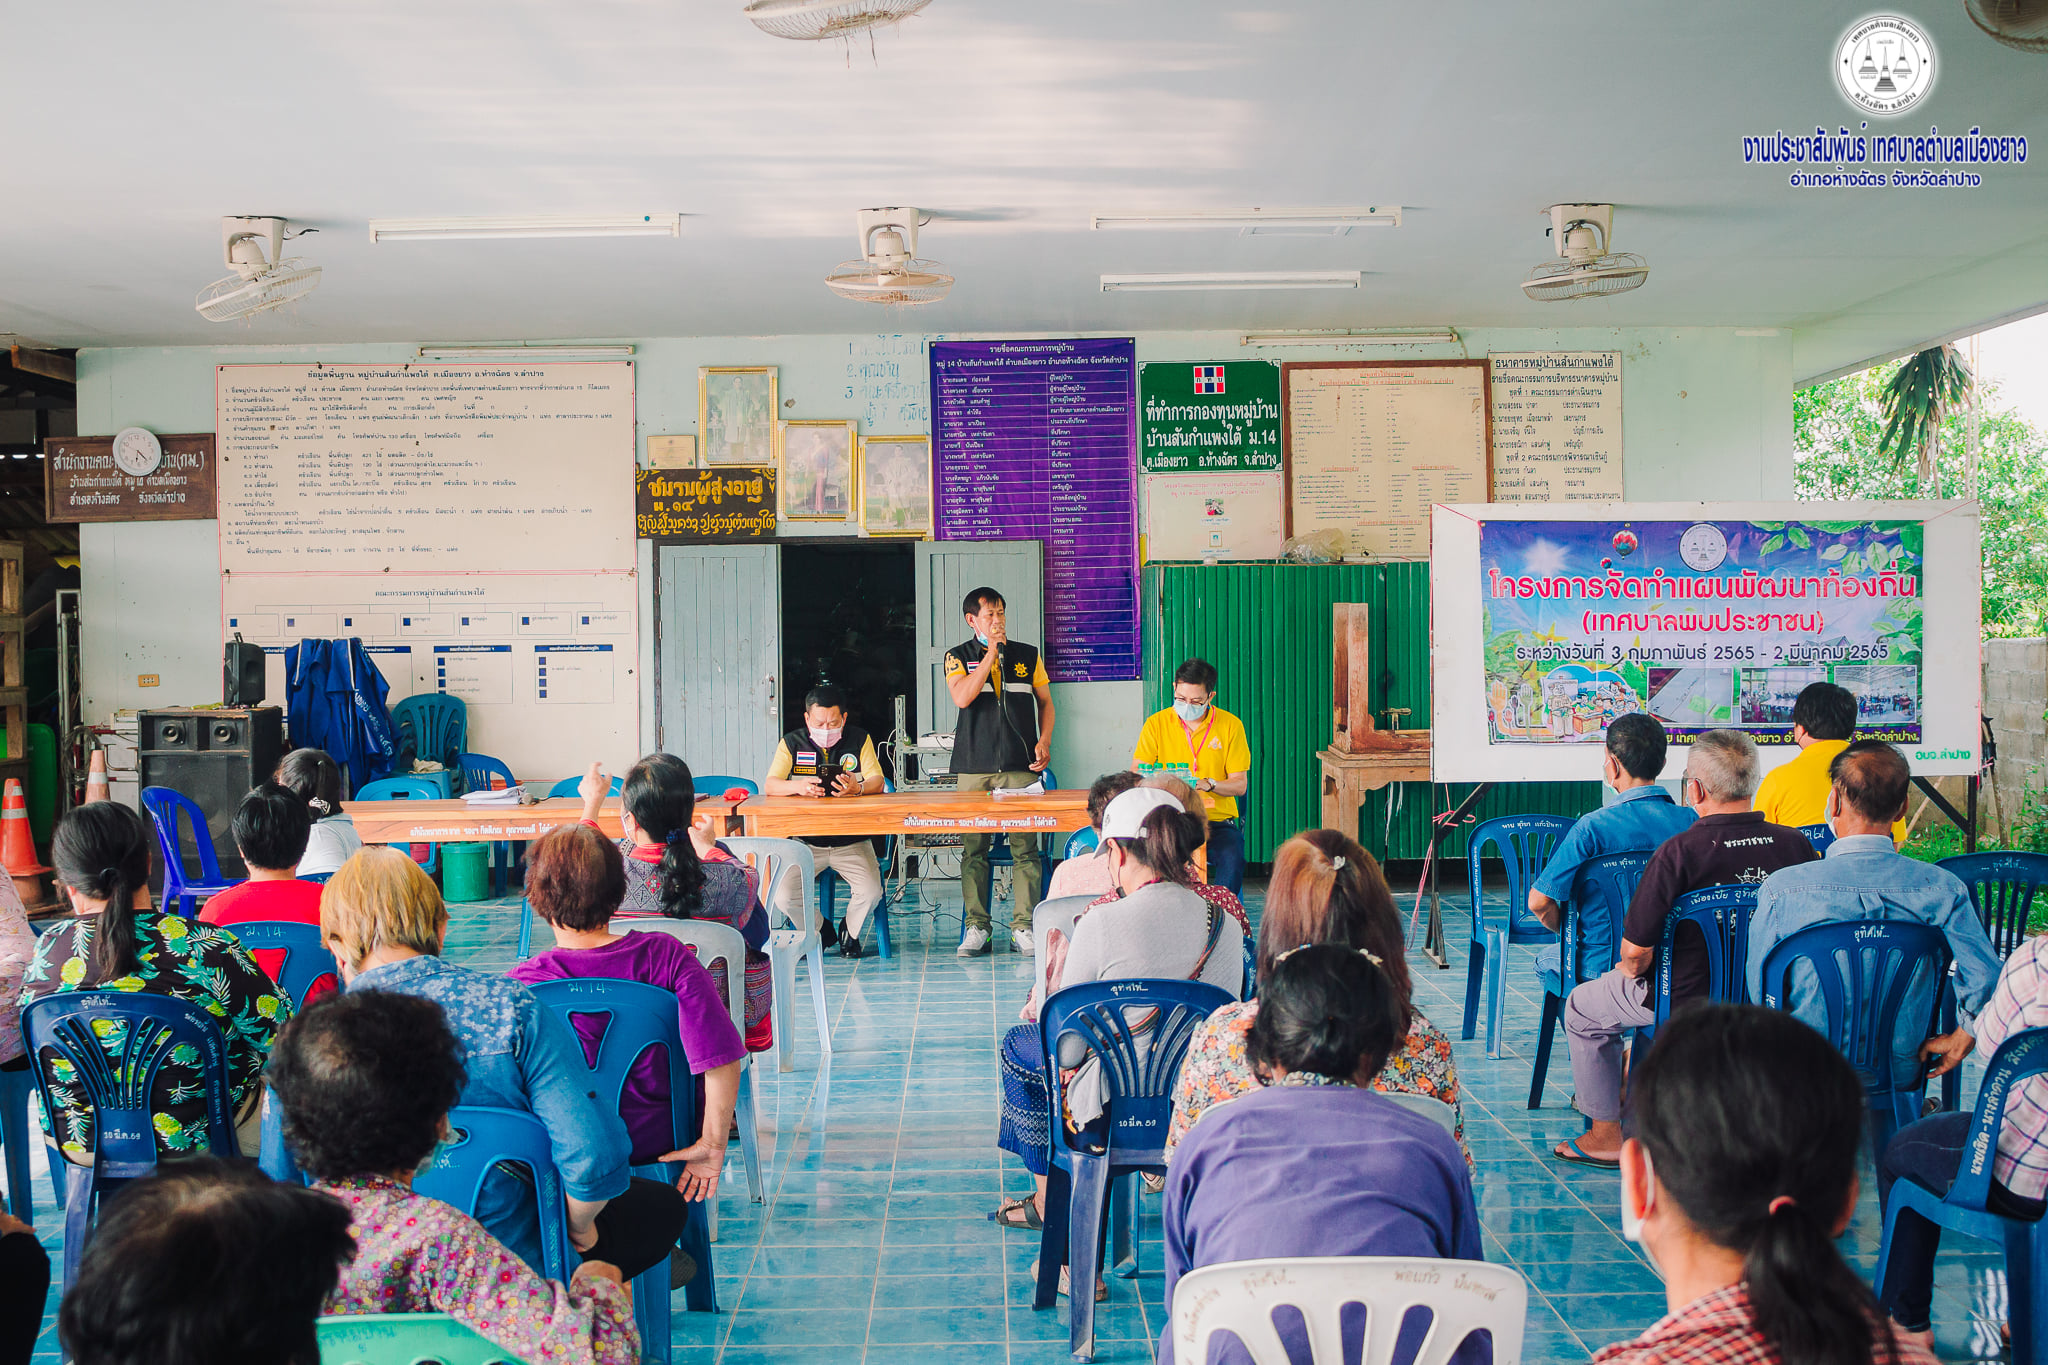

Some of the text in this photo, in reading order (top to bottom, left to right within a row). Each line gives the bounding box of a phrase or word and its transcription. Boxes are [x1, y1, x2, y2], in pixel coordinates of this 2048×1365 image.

[989, 343, 1074, 354] รายชื่อคณะกรรมการหมู่บ้าน
[1495, 354, 1613, 371] ธนาคารหมู่บ้านสันกำแพงใต้
[1146, 395, 1278, 427] ที่ทำการกองทุนหมู่บ้าน
[1147, 424, 1276, 447] บ้านสันกำแพงใต้ ม.14
[1147, 451, 1276, 468] ต.เมืองยาว อ.ห้างฉัตร จ.ลำปาง
[1489, 559, 1916, 601] โครงการจัดทำแผนพัฒนาท้องถิ่น
[1581, 607, 1825, 636] (เทศบาลพบประชาชน)
[1516, 637, 1605, 662] ระหว่างวันที่
[1611, 644, 1621, 661] 3
[1628, 640, 1708, 666] กุมภาพันธ์
[1713, 644, 1754, 661] 2565
[1774, 644, 1784, 660] 2
[1789, 639, 1846, 660] มีนาคม
[1849, 643, 1888, 660] 2565
[1915, 747, 1971, 761] อบจ.ลำปาง
[1724, 836, 1774, 848] พระราชทาน
